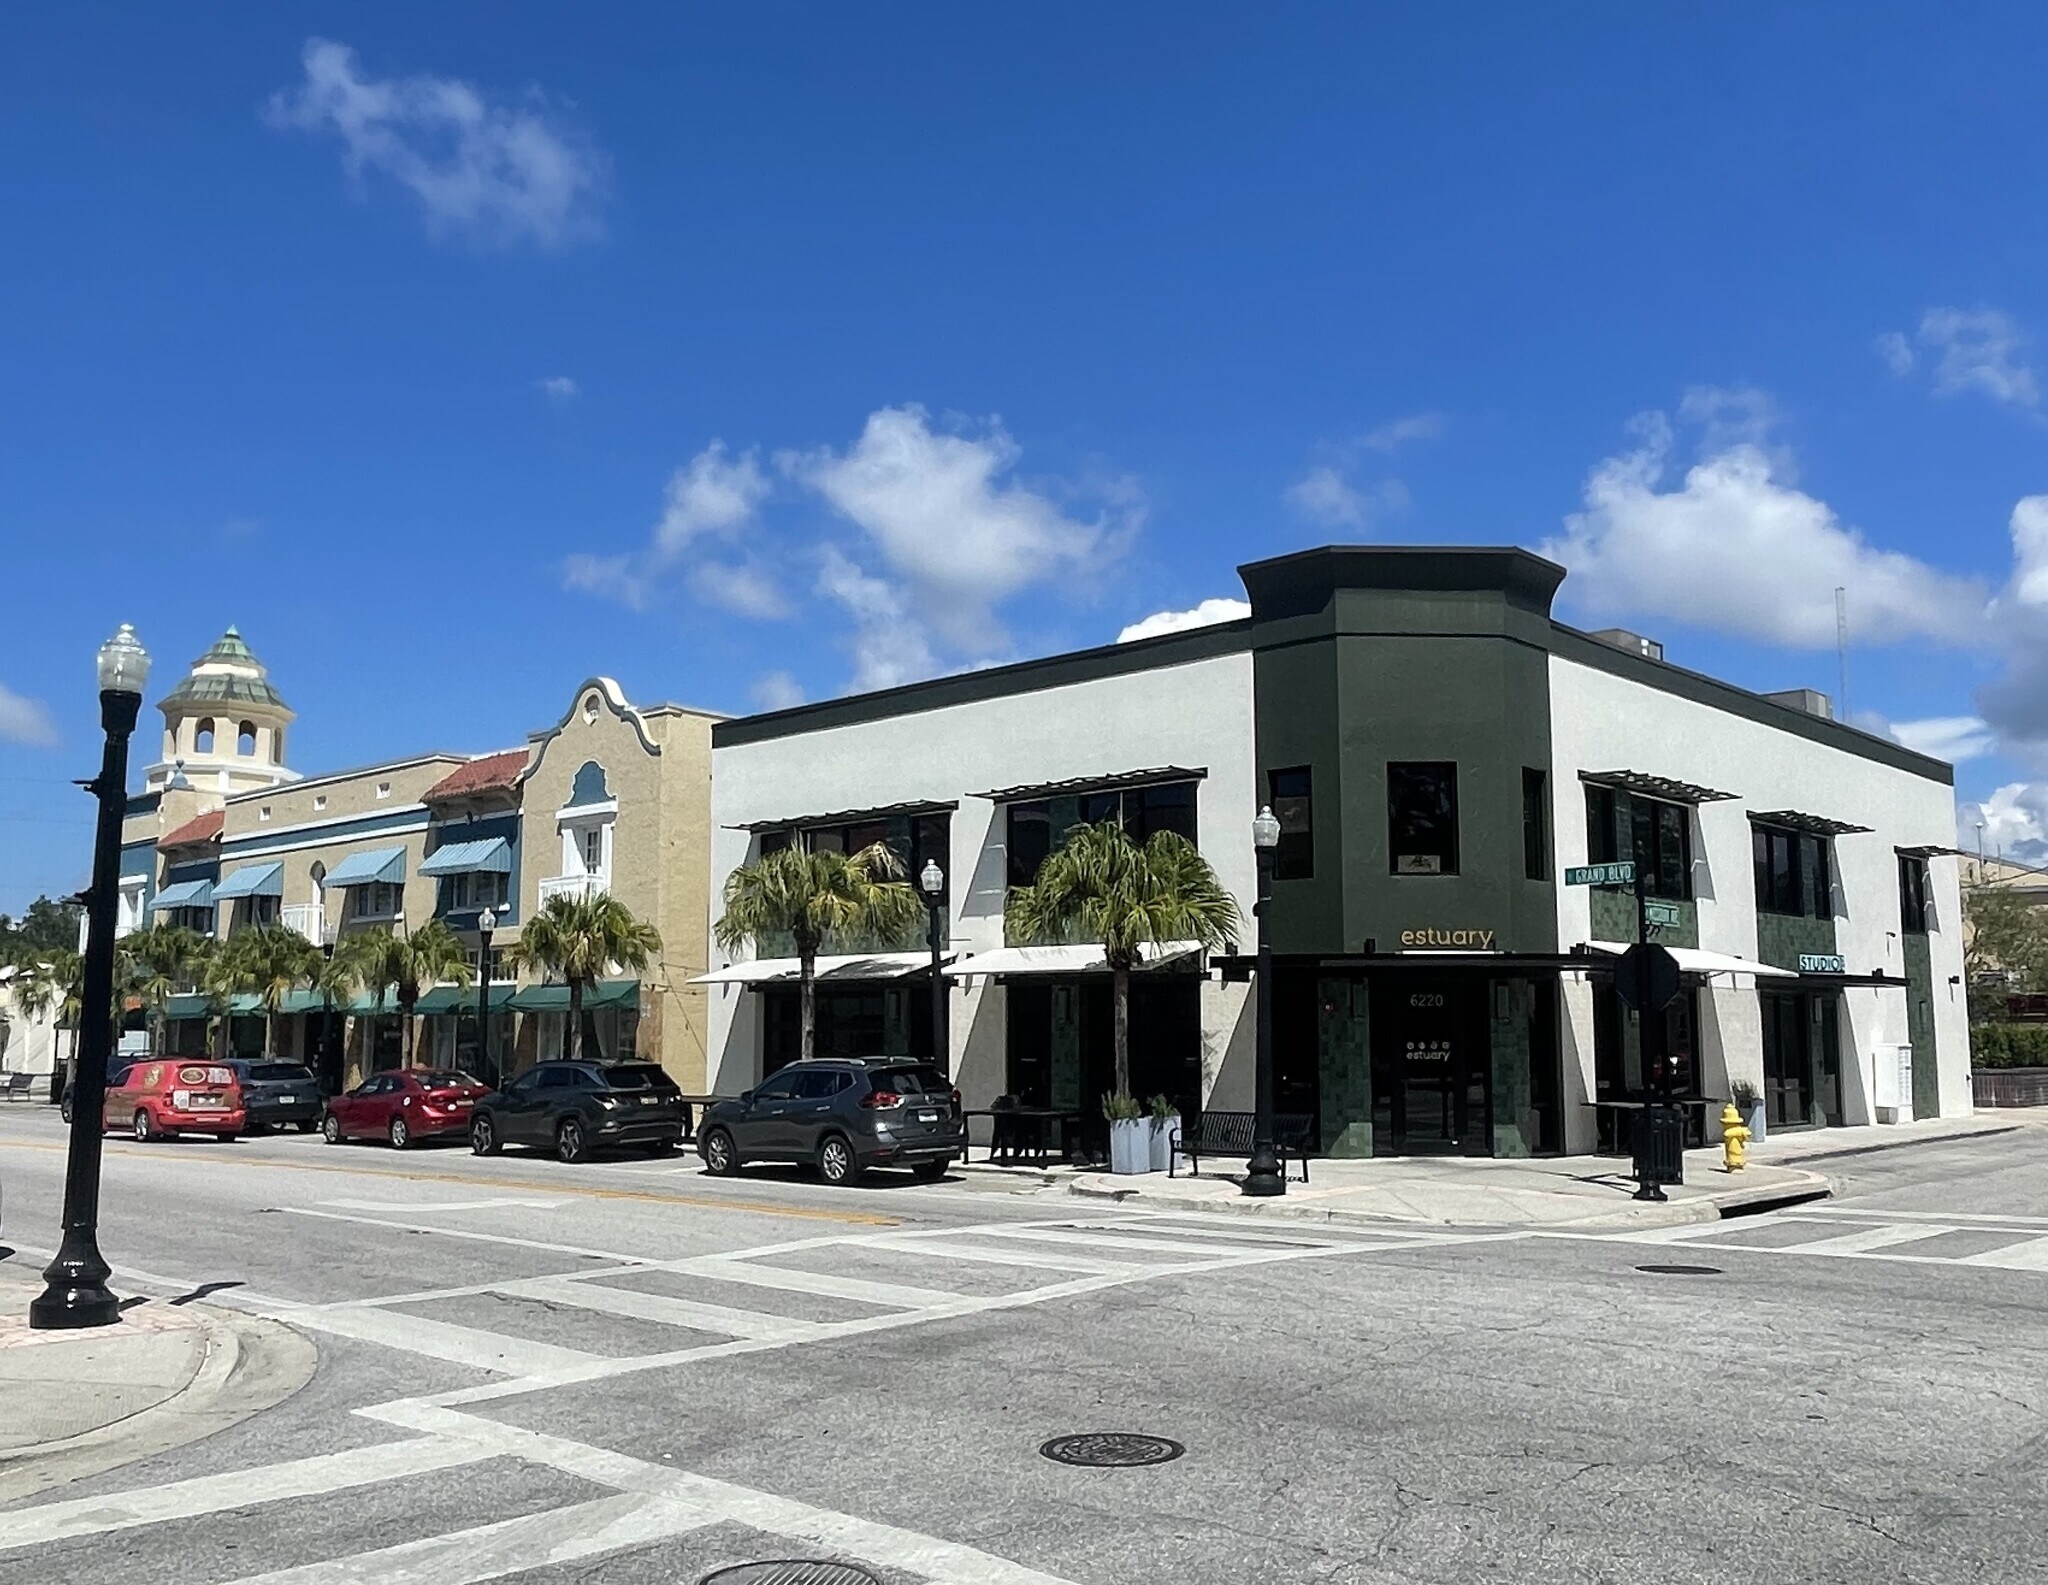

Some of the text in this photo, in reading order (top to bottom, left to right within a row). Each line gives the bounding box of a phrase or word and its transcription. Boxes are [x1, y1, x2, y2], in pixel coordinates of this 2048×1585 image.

[1575, 864, 1631, 883] GRAND BLVD
[1401, 927, 1494, 950] estuary
[1800, 956, 1840, 971] STUDIO
[1410, 994, 1444, 1007] 6220
[1406, 1051, 1451, 1062] estuary
